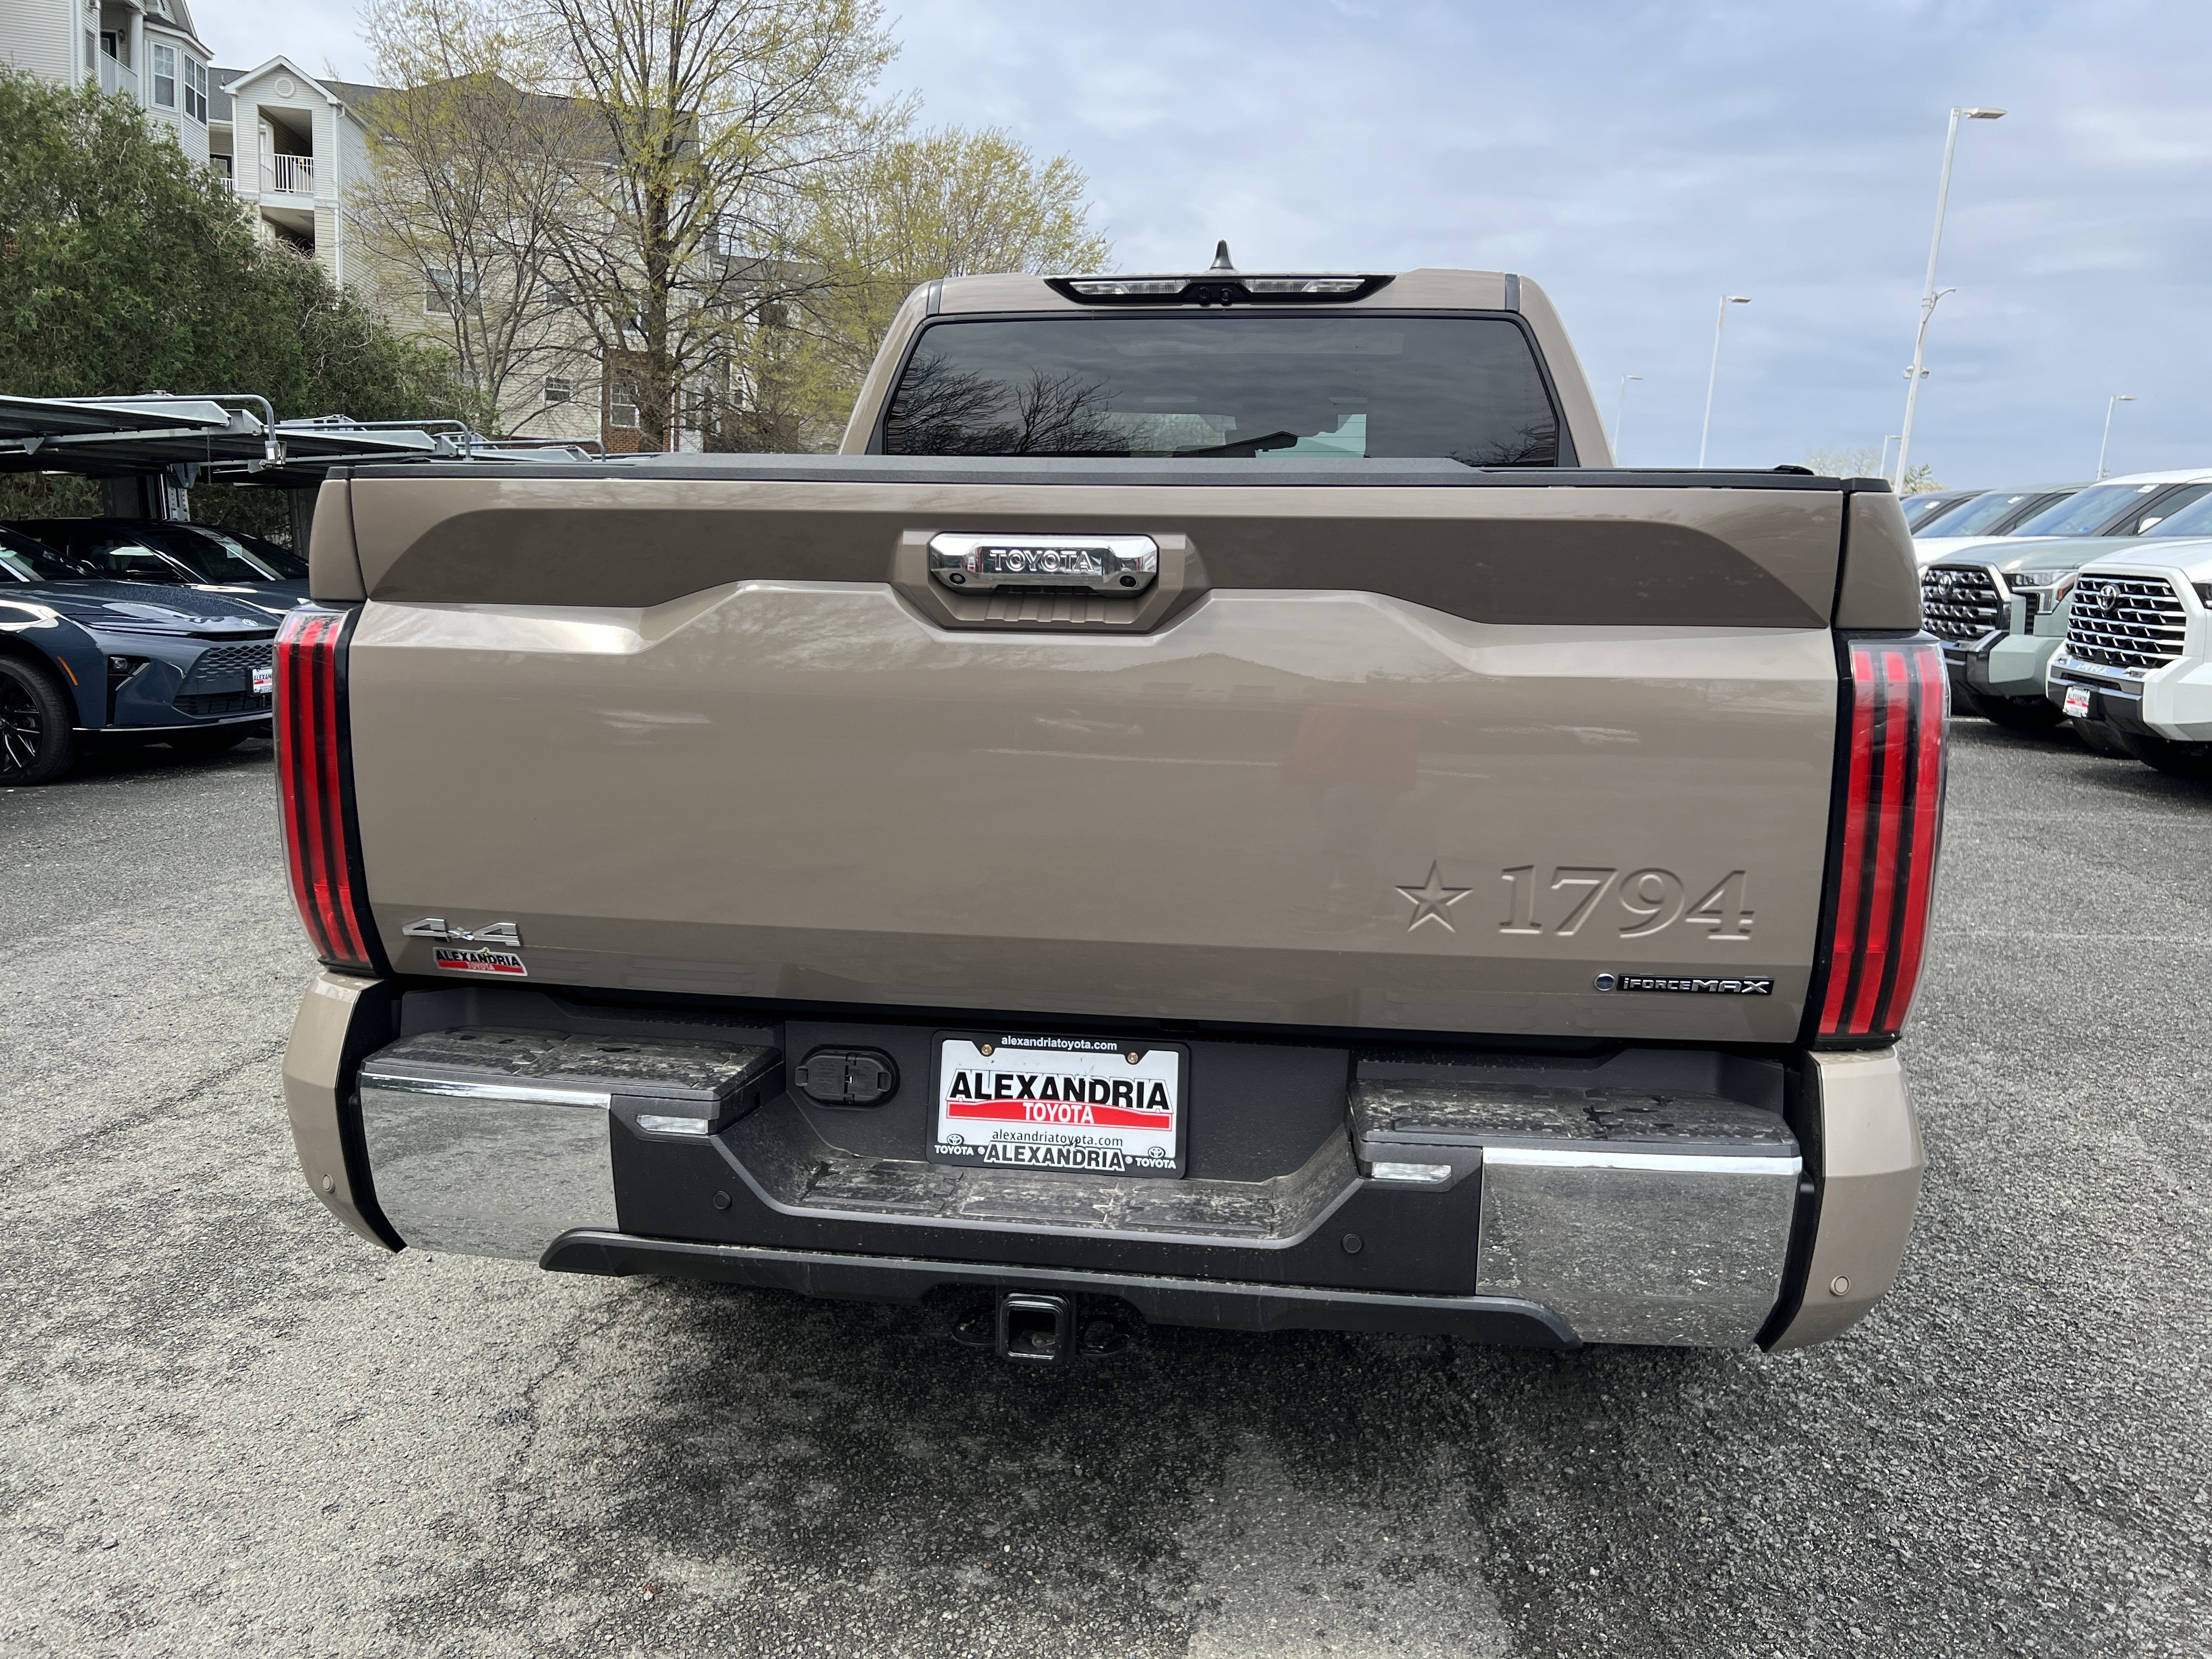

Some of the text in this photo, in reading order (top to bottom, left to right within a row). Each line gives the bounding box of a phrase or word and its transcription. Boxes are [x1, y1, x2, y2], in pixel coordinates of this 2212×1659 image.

[990, 549, 1094, 573] TOYOTA
[1498, 864, 1754, 940] 1794
[402, 917, 521, 946] 4x4
[436, 950, 521, 967] ALEXANDRIA
[467, 962, 496, 970] TOYOTA
[1001, 1035, 1117, 1051] alexandriatoyota.com
[949, 1071, 1170, 1110] ALEXANDRIA
[1023, 1102, 1094, 1124] TOYOTA
[992, 1129, 1123, 1147] alexandriatoyota.com
[934, 1144, 974, 1156] TOYOTA
[985, 1143, 1124, 1170] ALEXANDRIA
[1135, 1157, 1176, 1170] TOYOTA
